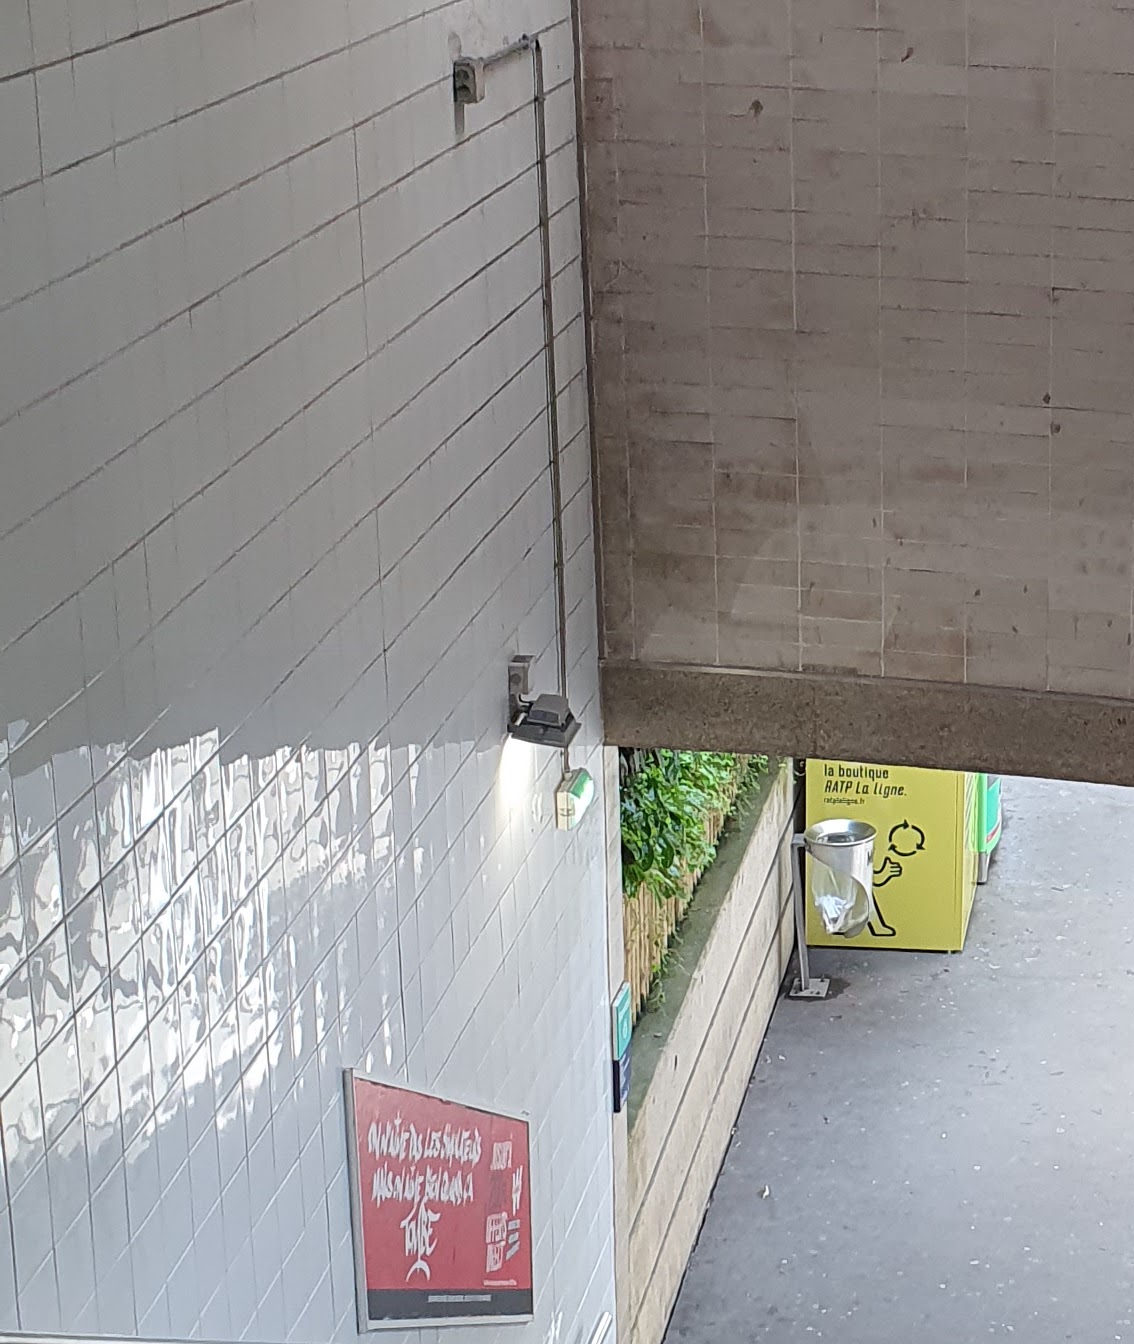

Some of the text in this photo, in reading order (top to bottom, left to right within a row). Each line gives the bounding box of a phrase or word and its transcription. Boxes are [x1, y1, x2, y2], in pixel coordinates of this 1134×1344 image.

[824, 764, 889, 781] la boutique
[824, 780, 853, 794] RATP
